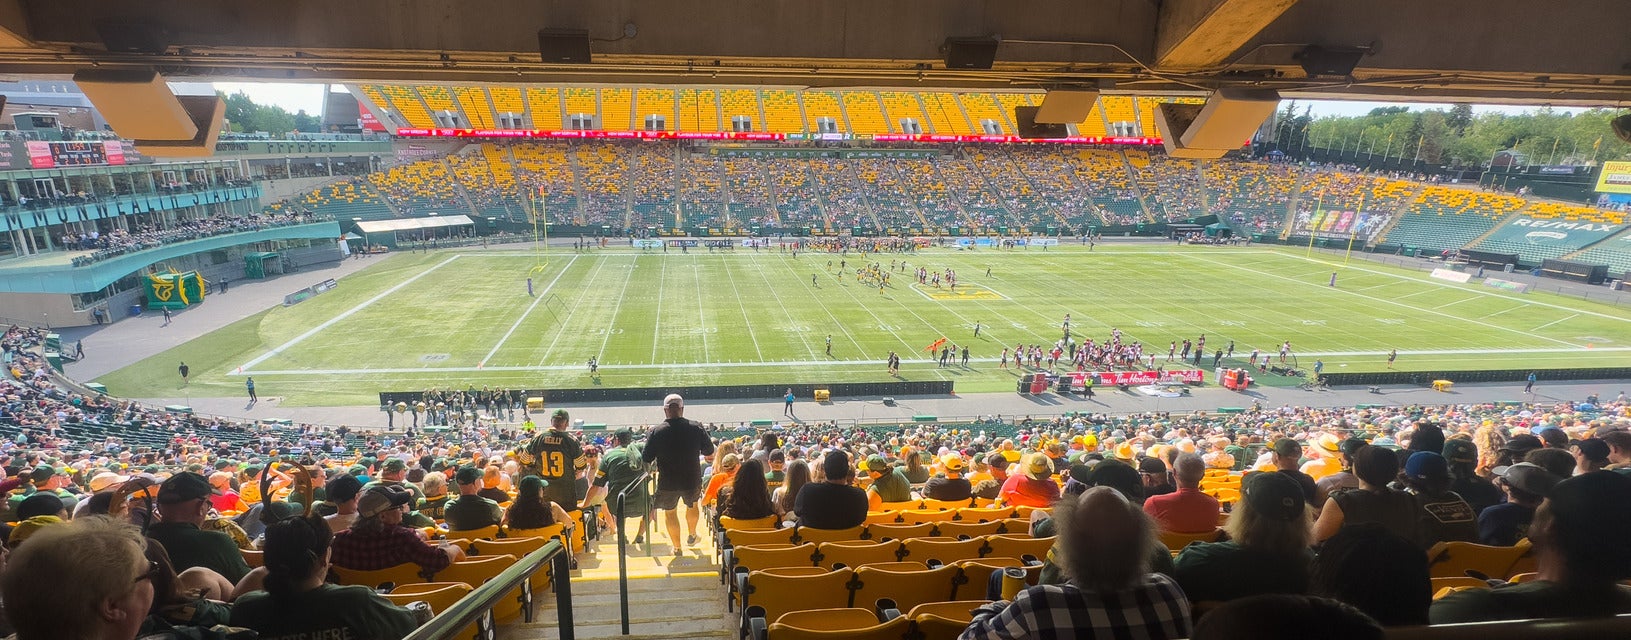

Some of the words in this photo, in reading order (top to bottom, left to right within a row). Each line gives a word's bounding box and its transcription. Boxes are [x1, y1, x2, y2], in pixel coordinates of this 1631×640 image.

[1512, 218, 1618, 232] RE/MAX
[544, 435, 563, 445] REILLY
[541, 450, 564, 477] 13
